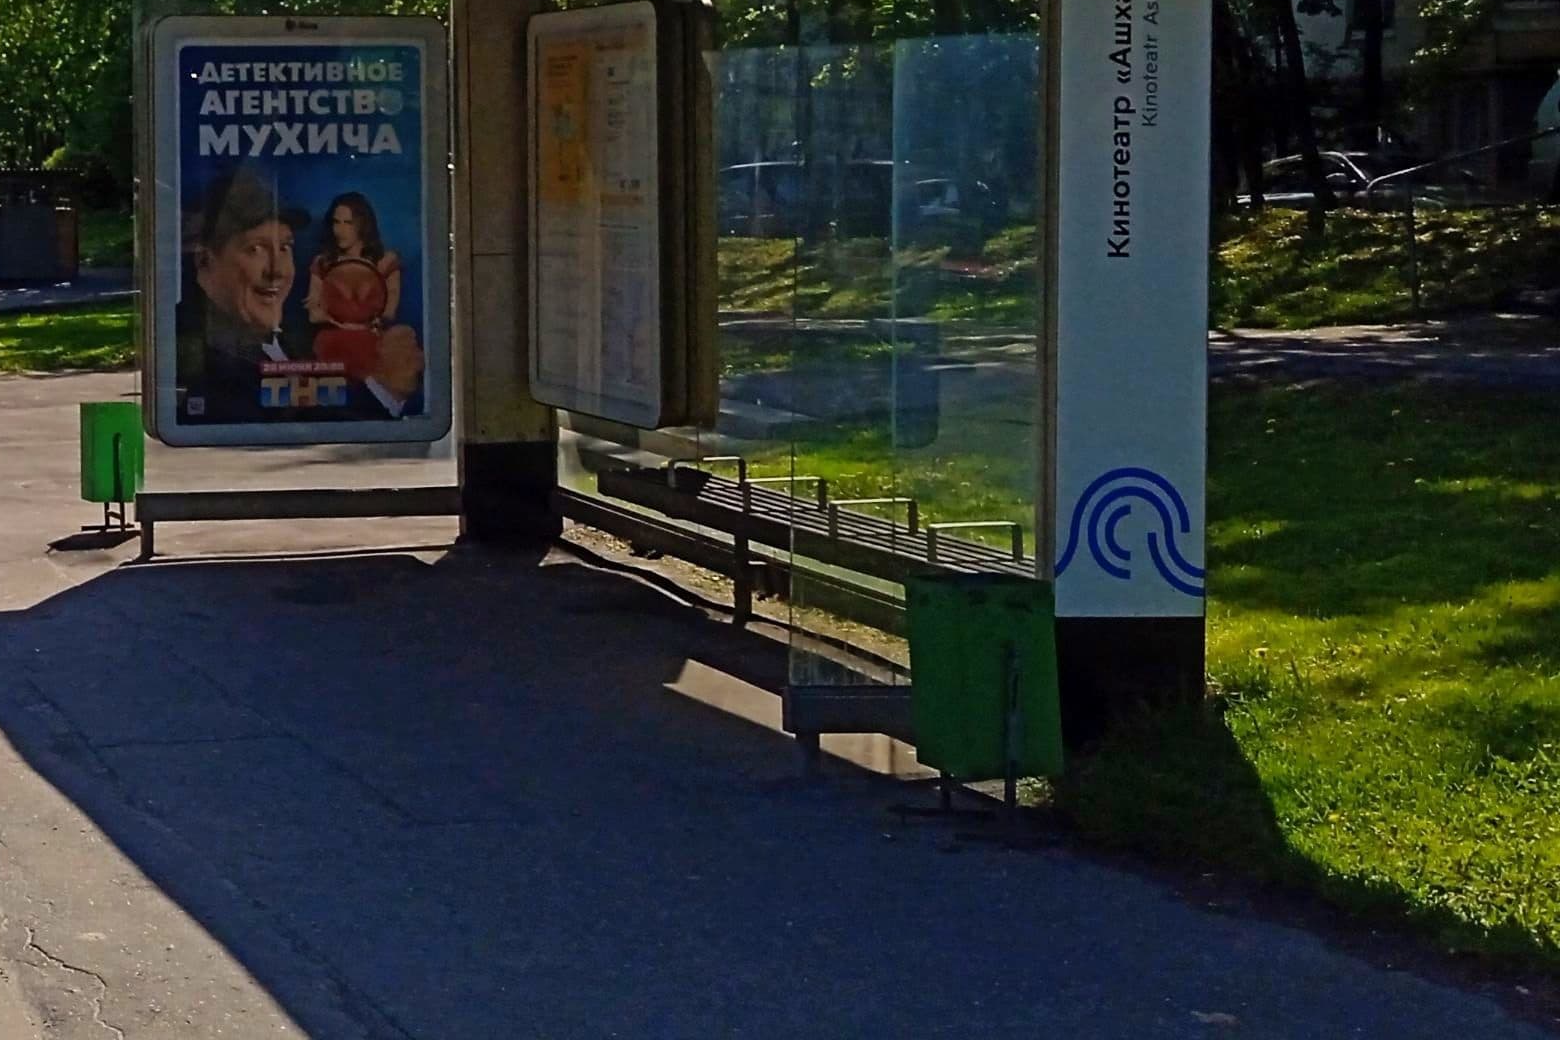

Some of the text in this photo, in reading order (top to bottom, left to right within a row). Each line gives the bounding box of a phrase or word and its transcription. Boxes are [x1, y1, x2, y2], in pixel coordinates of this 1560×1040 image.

[198, 61, 403, 85] ДЕТЕКТИВНОЕ
[1142, 33, 1159, 128] Kinoteatr
[198, 88, 403, 116] АГЕНТСТВО
[198, 121, 403, 157] МУХИЧА
[1107, 95, 1137, 259] Кинотеатр
[260, 376, 346, 408] ТНТ
